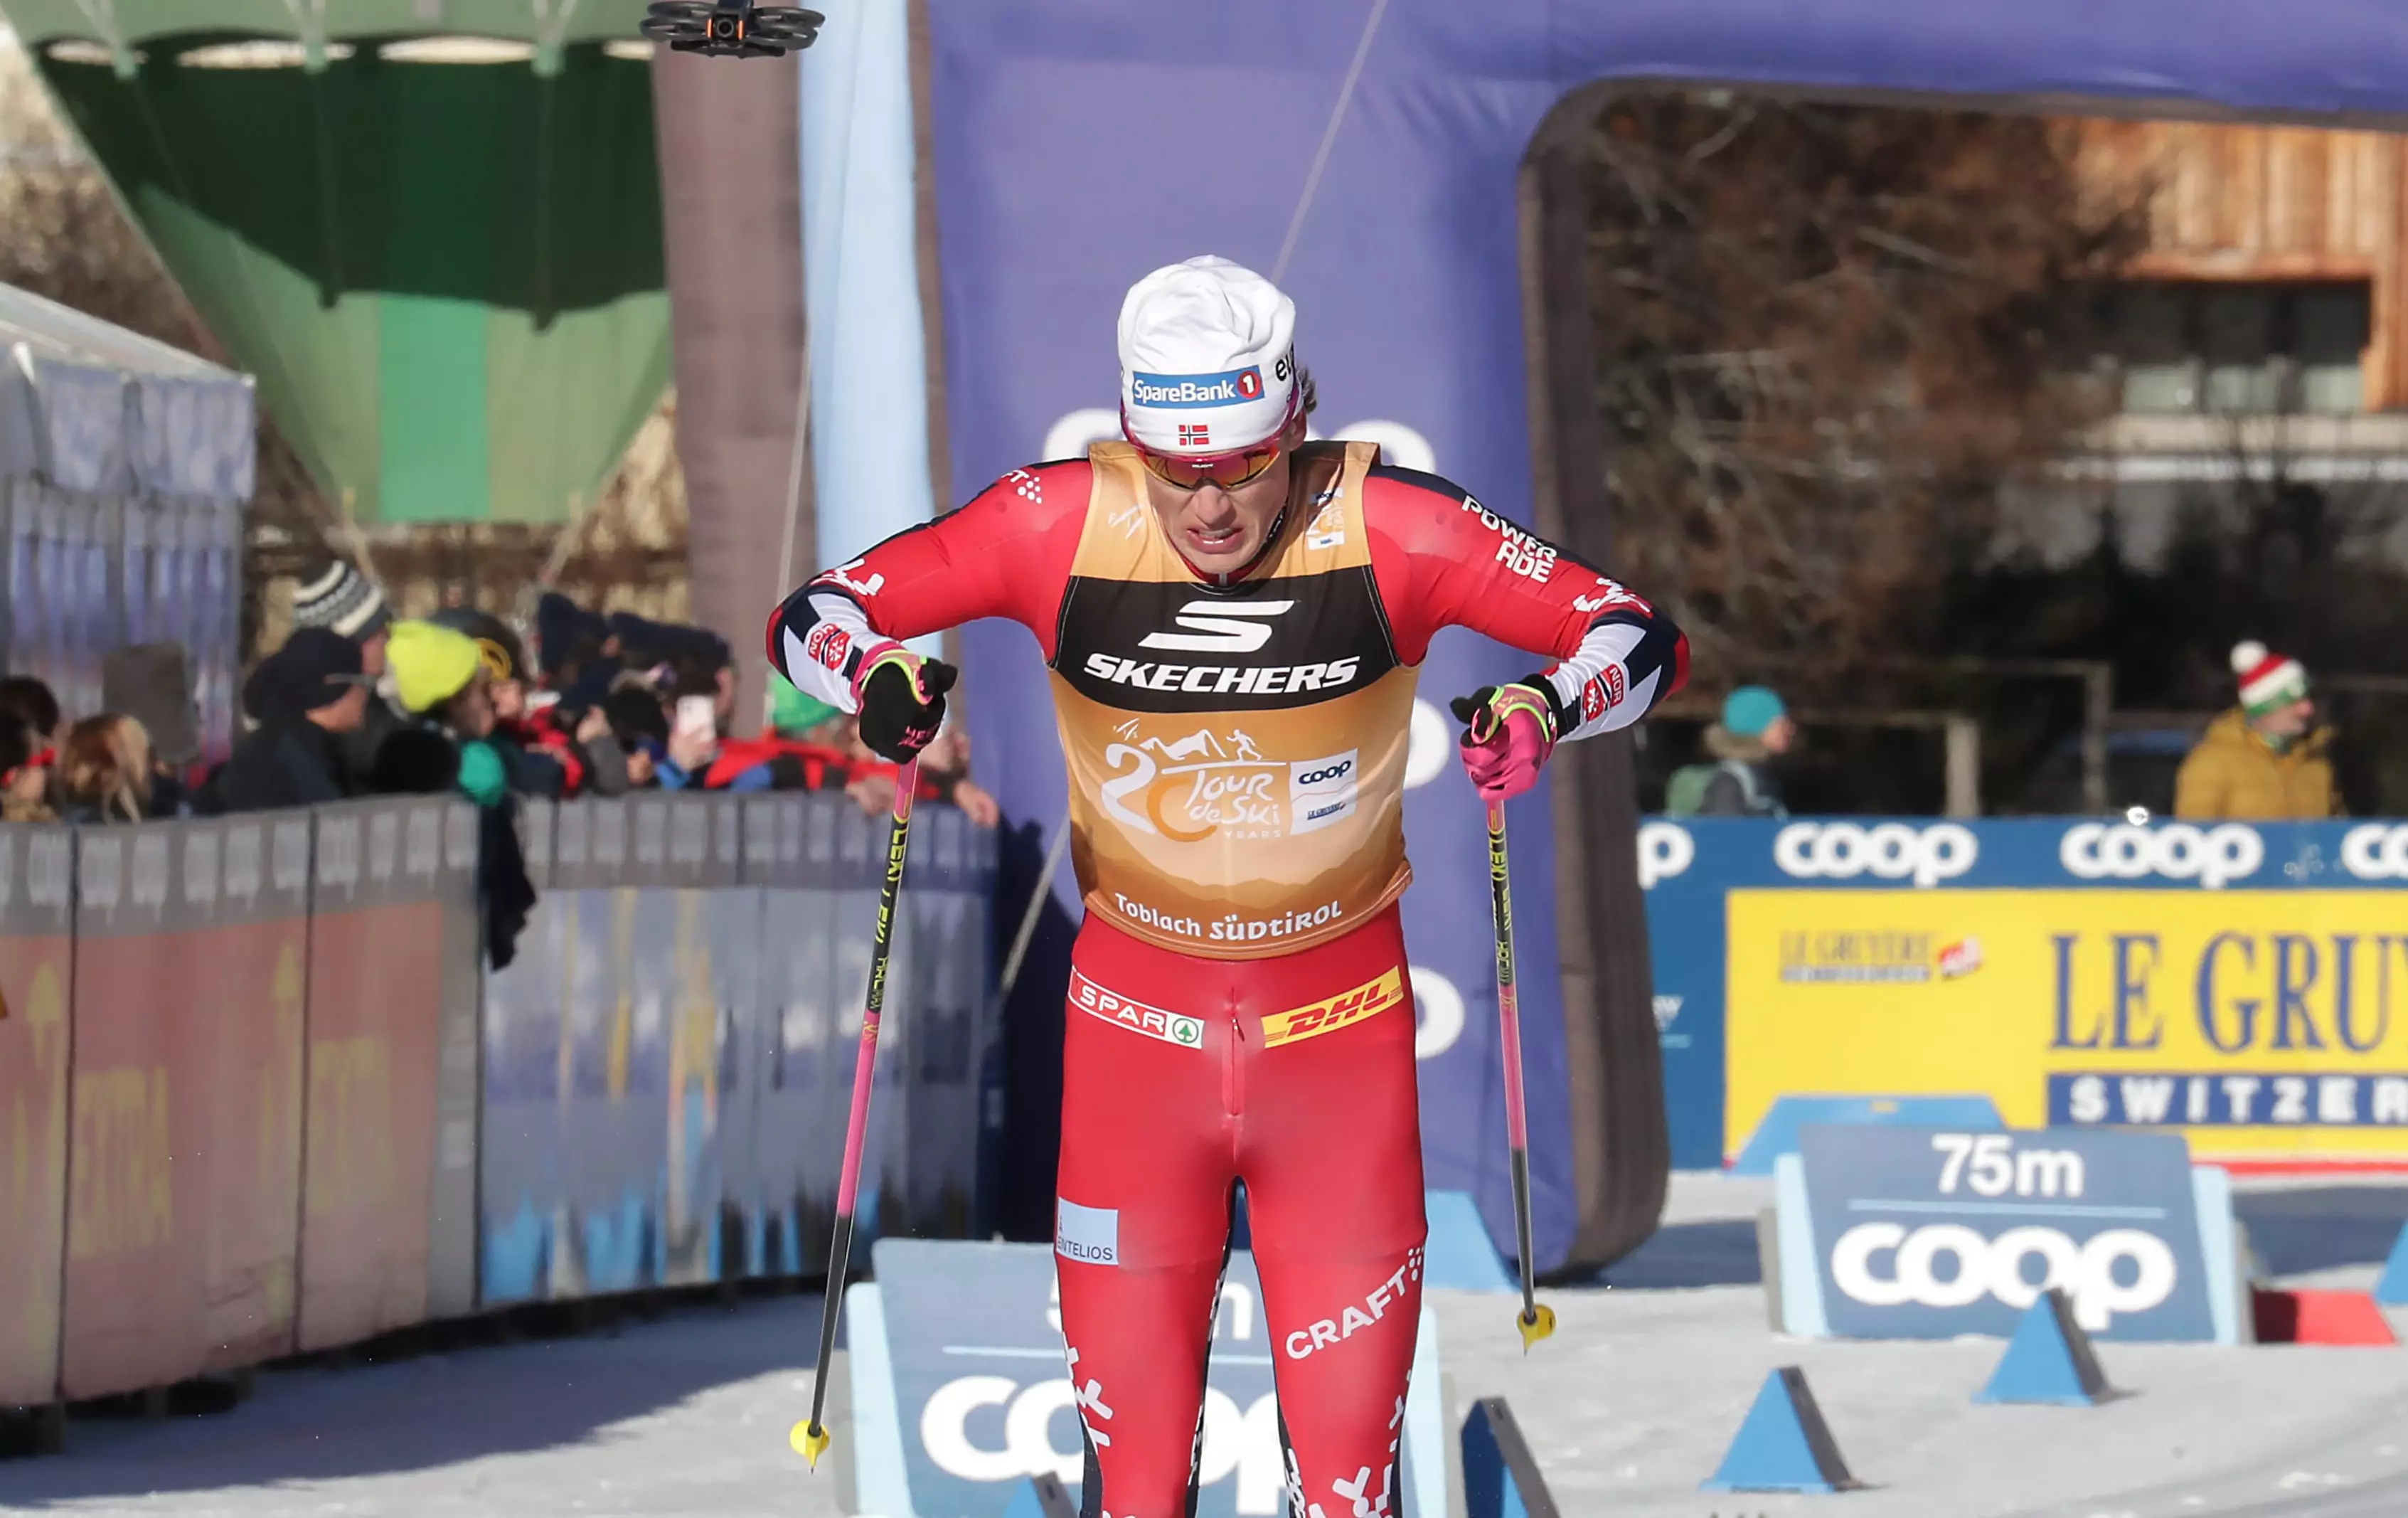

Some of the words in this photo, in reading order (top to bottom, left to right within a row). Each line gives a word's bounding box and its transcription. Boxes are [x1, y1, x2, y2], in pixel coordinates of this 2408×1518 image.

[1134, 379, 1235, 404] SpareBank
[1461, 495, 1557, 563] POWER
[1495, 540, 1554, 583] ADE
[1083, 652, 1360, 694] SKECHERS
[1610, 667, 1624, 703] NOR
[1299, 760, 1351, 784] coop
[1224, 829, 1282, 839] YEARS
[1774, 823, 1978, 888] coop
[2060, 824, 2264, 888] coop
[1114, 893, 1201, 938] Toblach
[1080, 984, 1165, 1033] SPAR
[1286, 983, 1392, 1036] DHL
[2049, 934, 2165, 1051] LE
[2193, 931, 2408, 1054] GRU
[2069, 1075, 2408, 1124] SWITZER
[1932, 1134, 2084, 1196] 75m
[1832, 1223, 2177, 1330] coop
[1285, 1265, 1407, 1360] CRAFT
